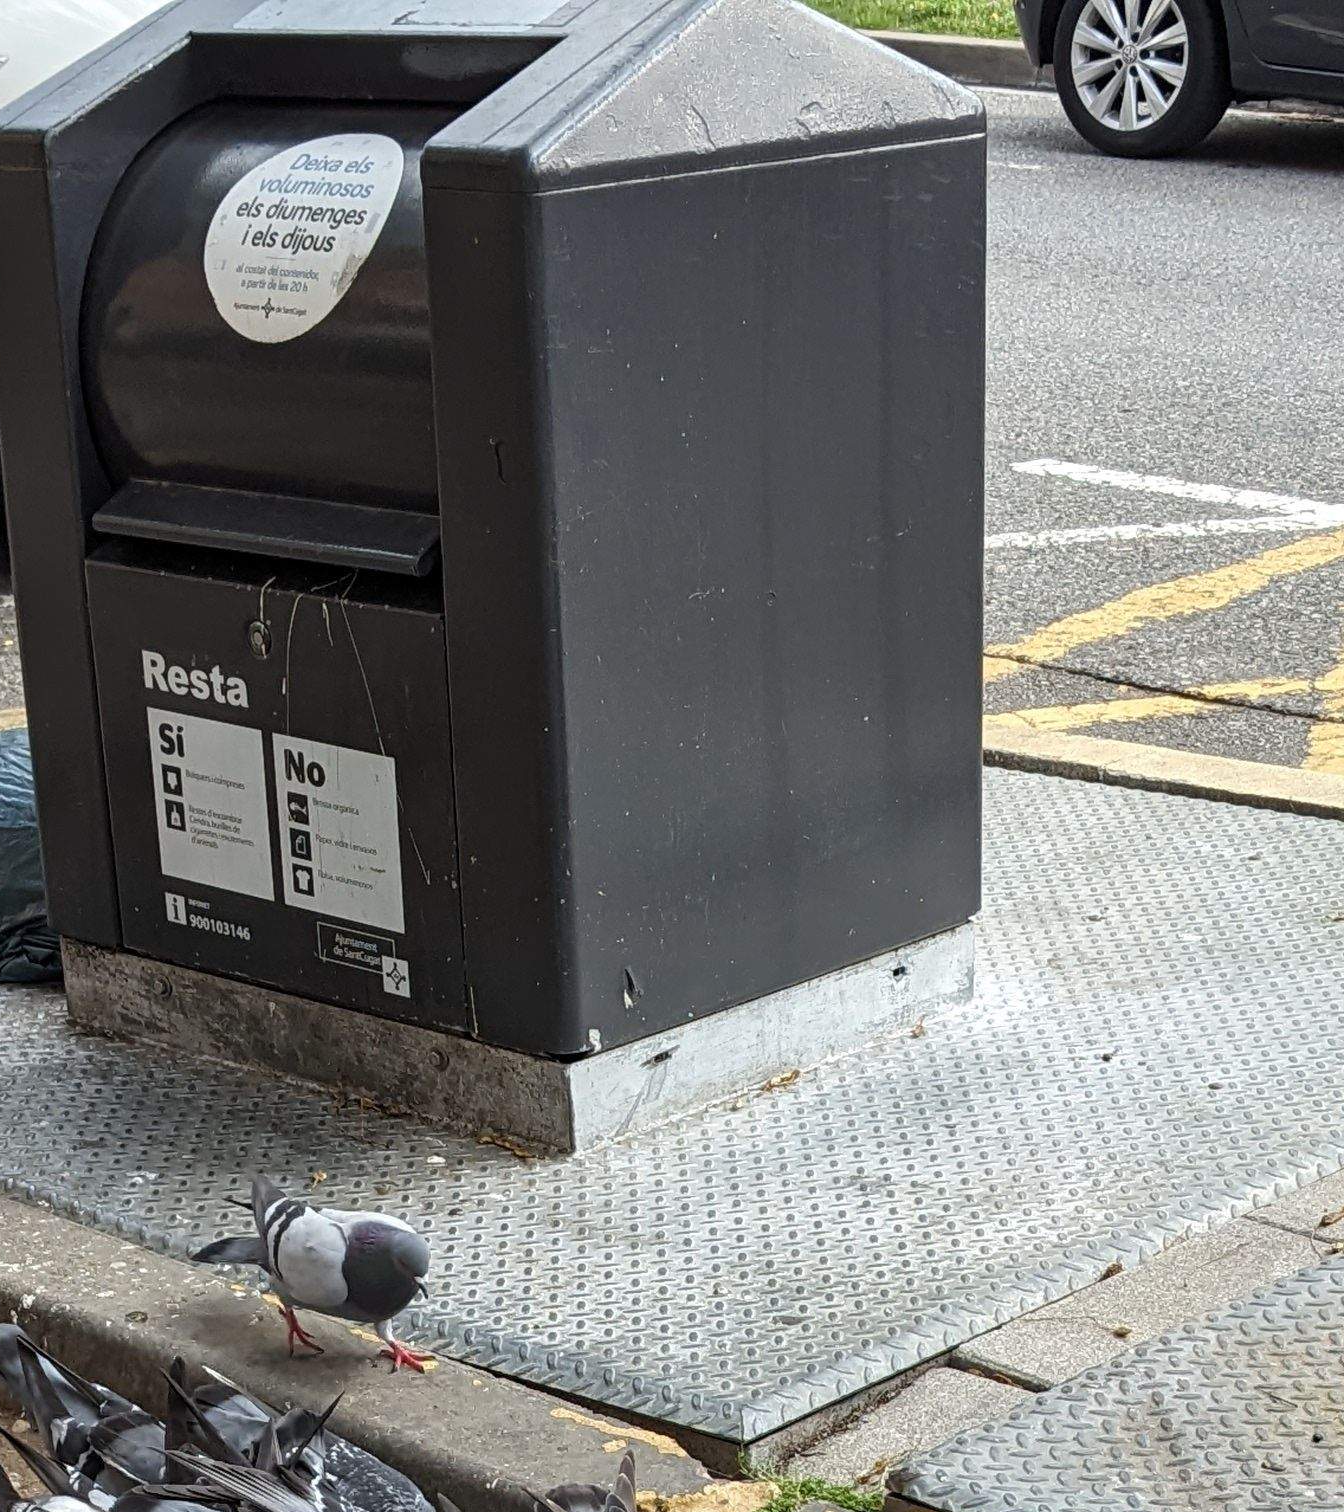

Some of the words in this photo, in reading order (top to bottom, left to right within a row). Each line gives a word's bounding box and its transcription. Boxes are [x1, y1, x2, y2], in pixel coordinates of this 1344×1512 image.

[289, 153, 343, 173] Deixa
[344, 155, 374, 174] els
[258, 173, 375, 199] voluminosos
[236, 196, 264, 219] els
[266, 197, 367, 230] diumenges
[241, 224, 252, 246] i
[251, 223, 279, 248] els
[281, 225, 336, 255] dijous
[289, 281, 302, 293] 20
[141, 648, 250, 708] Resta
[283, 748, 327, 788] No
[188, 913, 251, 941] 900103146
